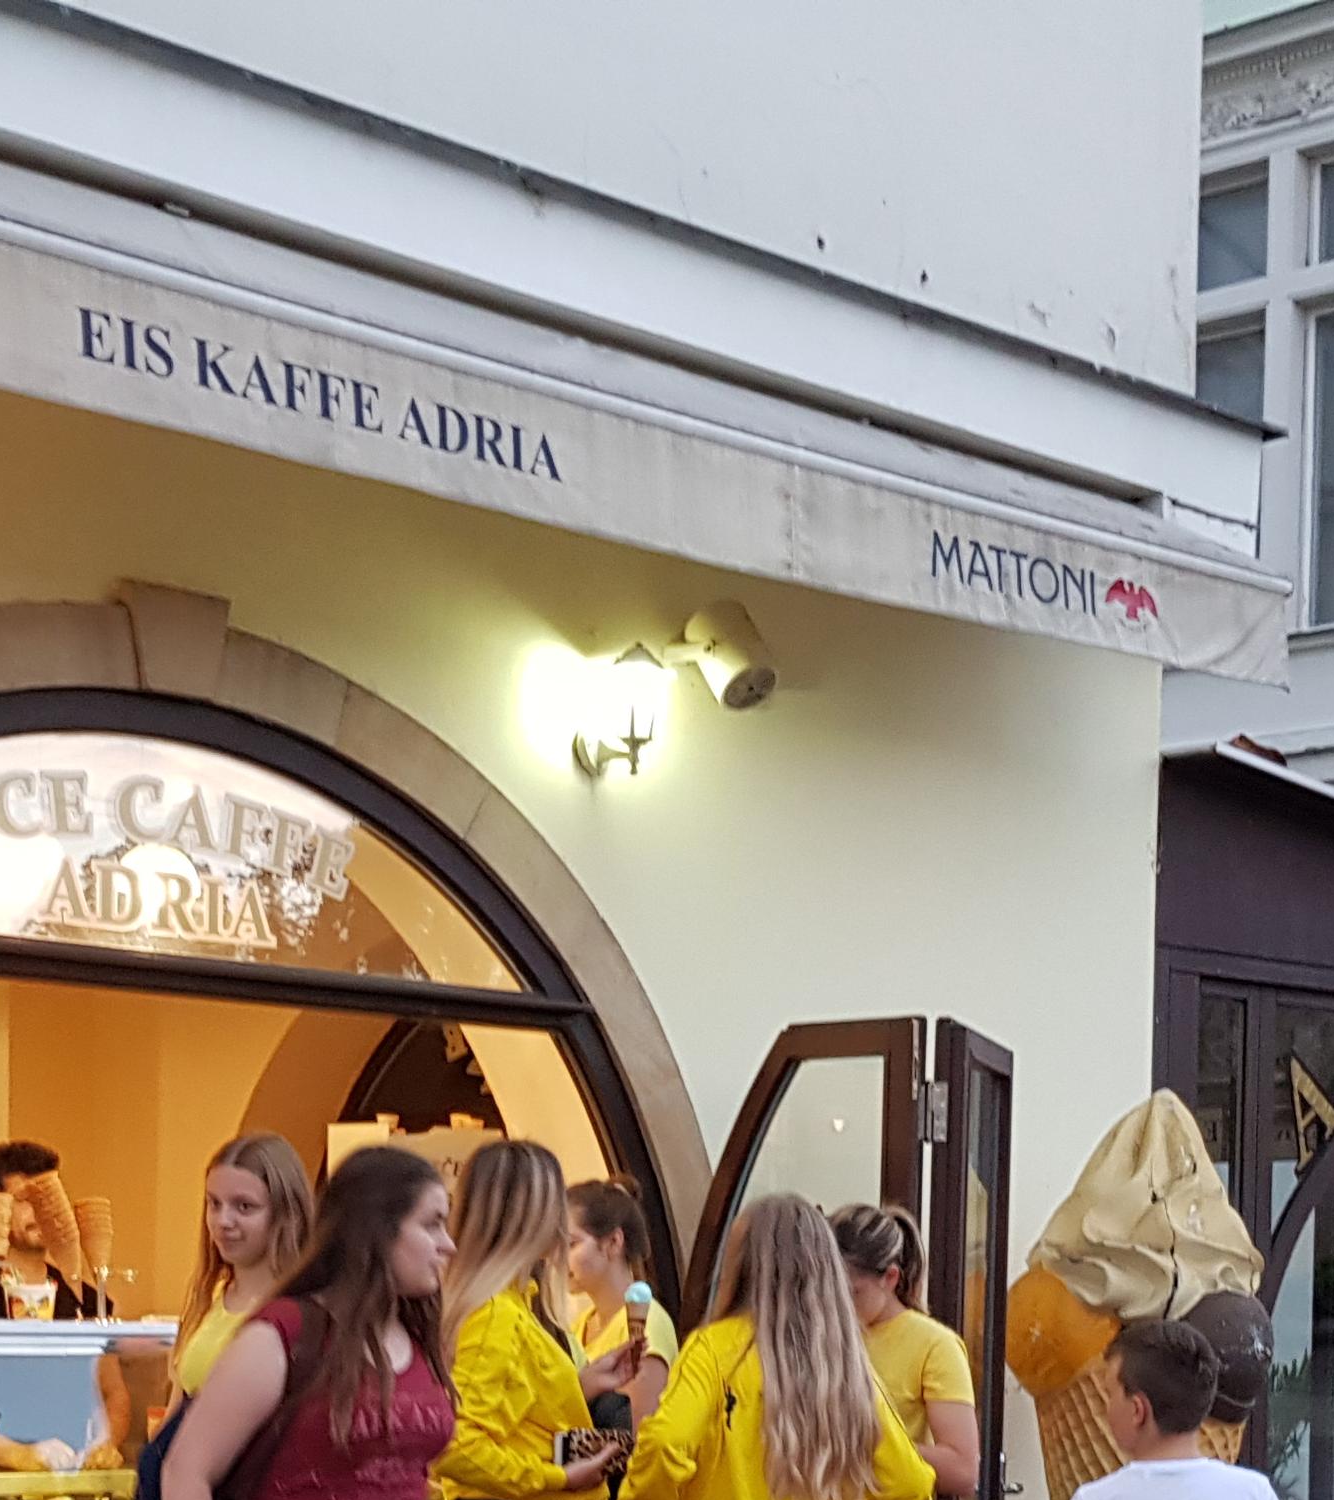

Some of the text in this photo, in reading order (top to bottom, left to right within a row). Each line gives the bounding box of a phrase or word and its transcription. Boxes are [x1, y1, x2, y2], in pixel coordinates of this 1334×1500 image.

[78, 306, 563, 483] EIS KAFFE ADRIA
[931, 529, 1097, 616] MATTONI
[113, 774, 355, 899] CAFFE
[45, 857, 277, 948] ADRIA
